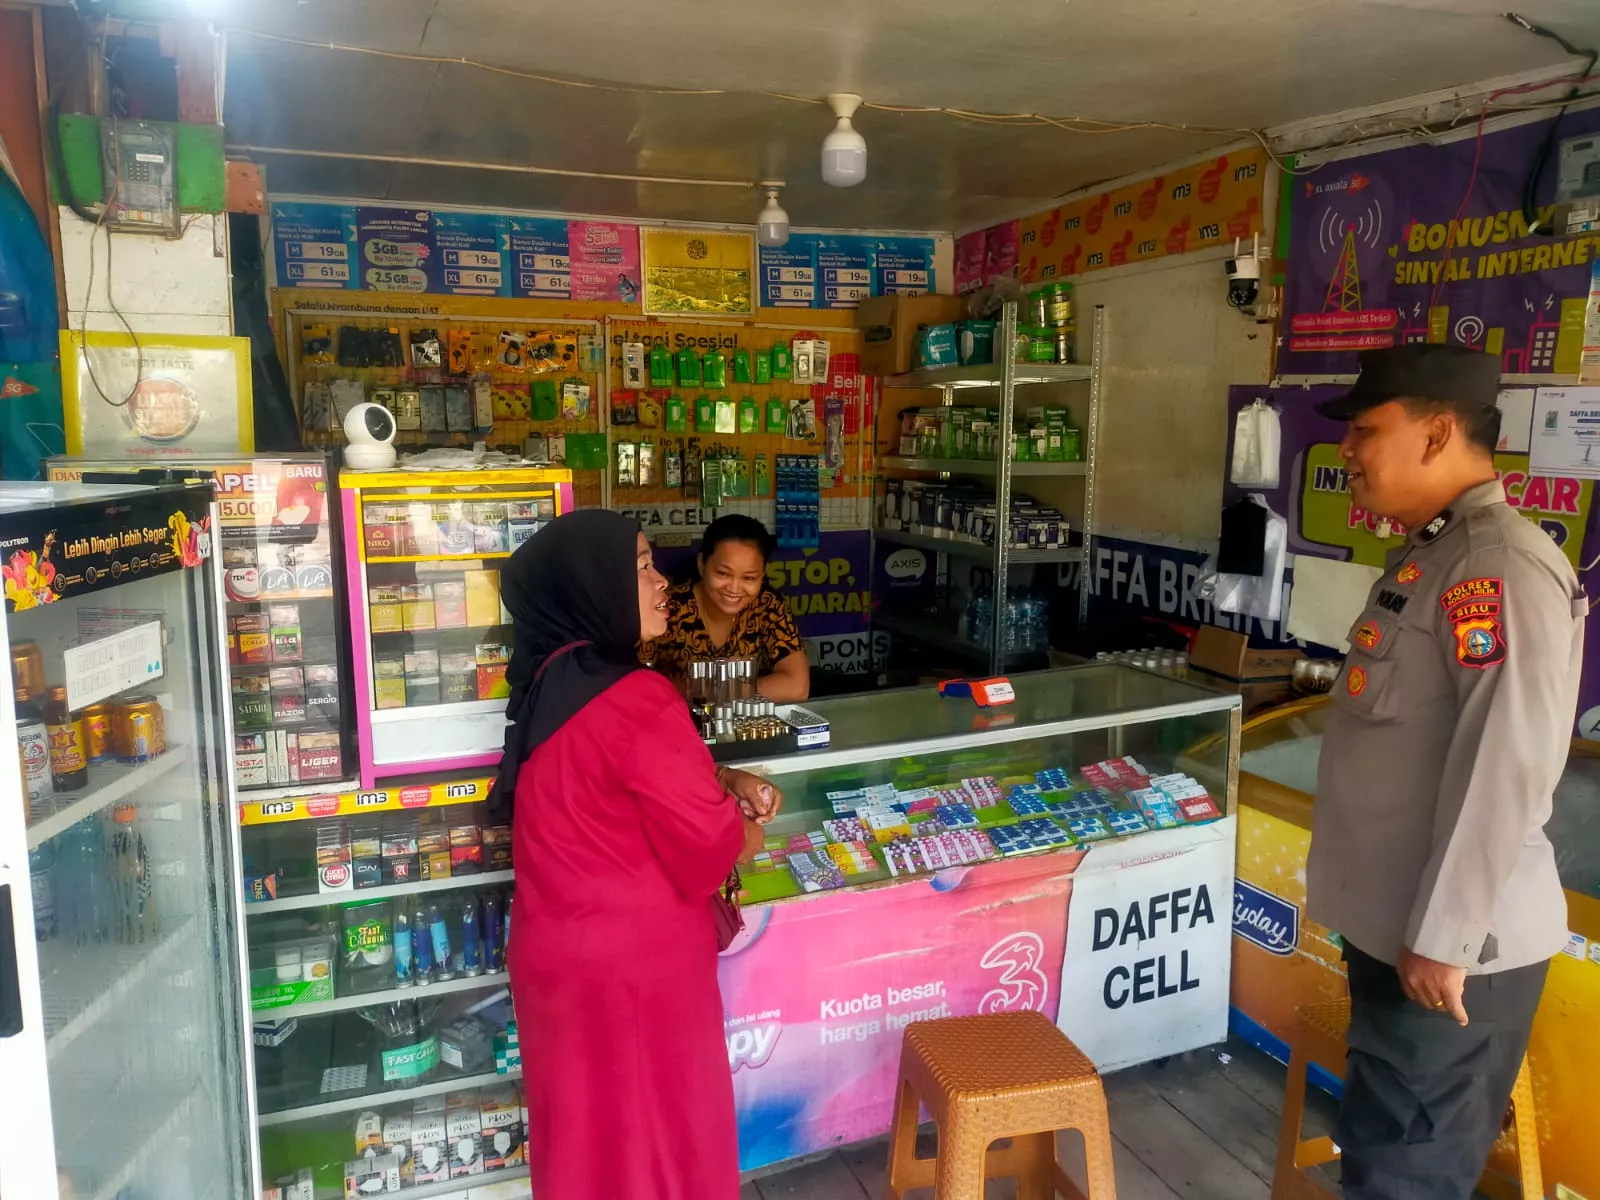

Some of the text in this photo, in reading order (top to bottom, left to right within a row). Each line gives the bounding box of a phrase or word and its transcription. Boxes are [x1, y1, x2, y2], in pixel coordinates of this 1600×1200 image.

[1395, 255, 1472, 285] SINYAL
[294, 300, 326, 310] Selalu
[5, 383, 22, 393] 5G
[834, 374, 860, 388] Beli
[286, 466, 322, 478] BARU
[64, 526, 168, 560] Lebih Dingin Lebih Segar
[368, 540, 390, 548] NIKO
[891, 558, 921, 570] AXIS
[766, 558, 855, 587] STOP,
[1446, 580, 1492, 600] POLRES
[1456, 604, 1489, 618] RIAU
[308, 694, 337, 706] SERGIO
[274, 709, 304, 718] RAZOR
[302, 756, 338, 768] LIGER
[1092, 884, 1214, 952] DAFFA
[1104, 950, 1200, 1010] CELL
[820, 980, 947, 1020] Kuota besar,
[728, 1008, 781, 1027] dan isi ulang
[820, 1002, 952, 1046] harga hemat.
[388, 1053, 416, 1066] FAST
